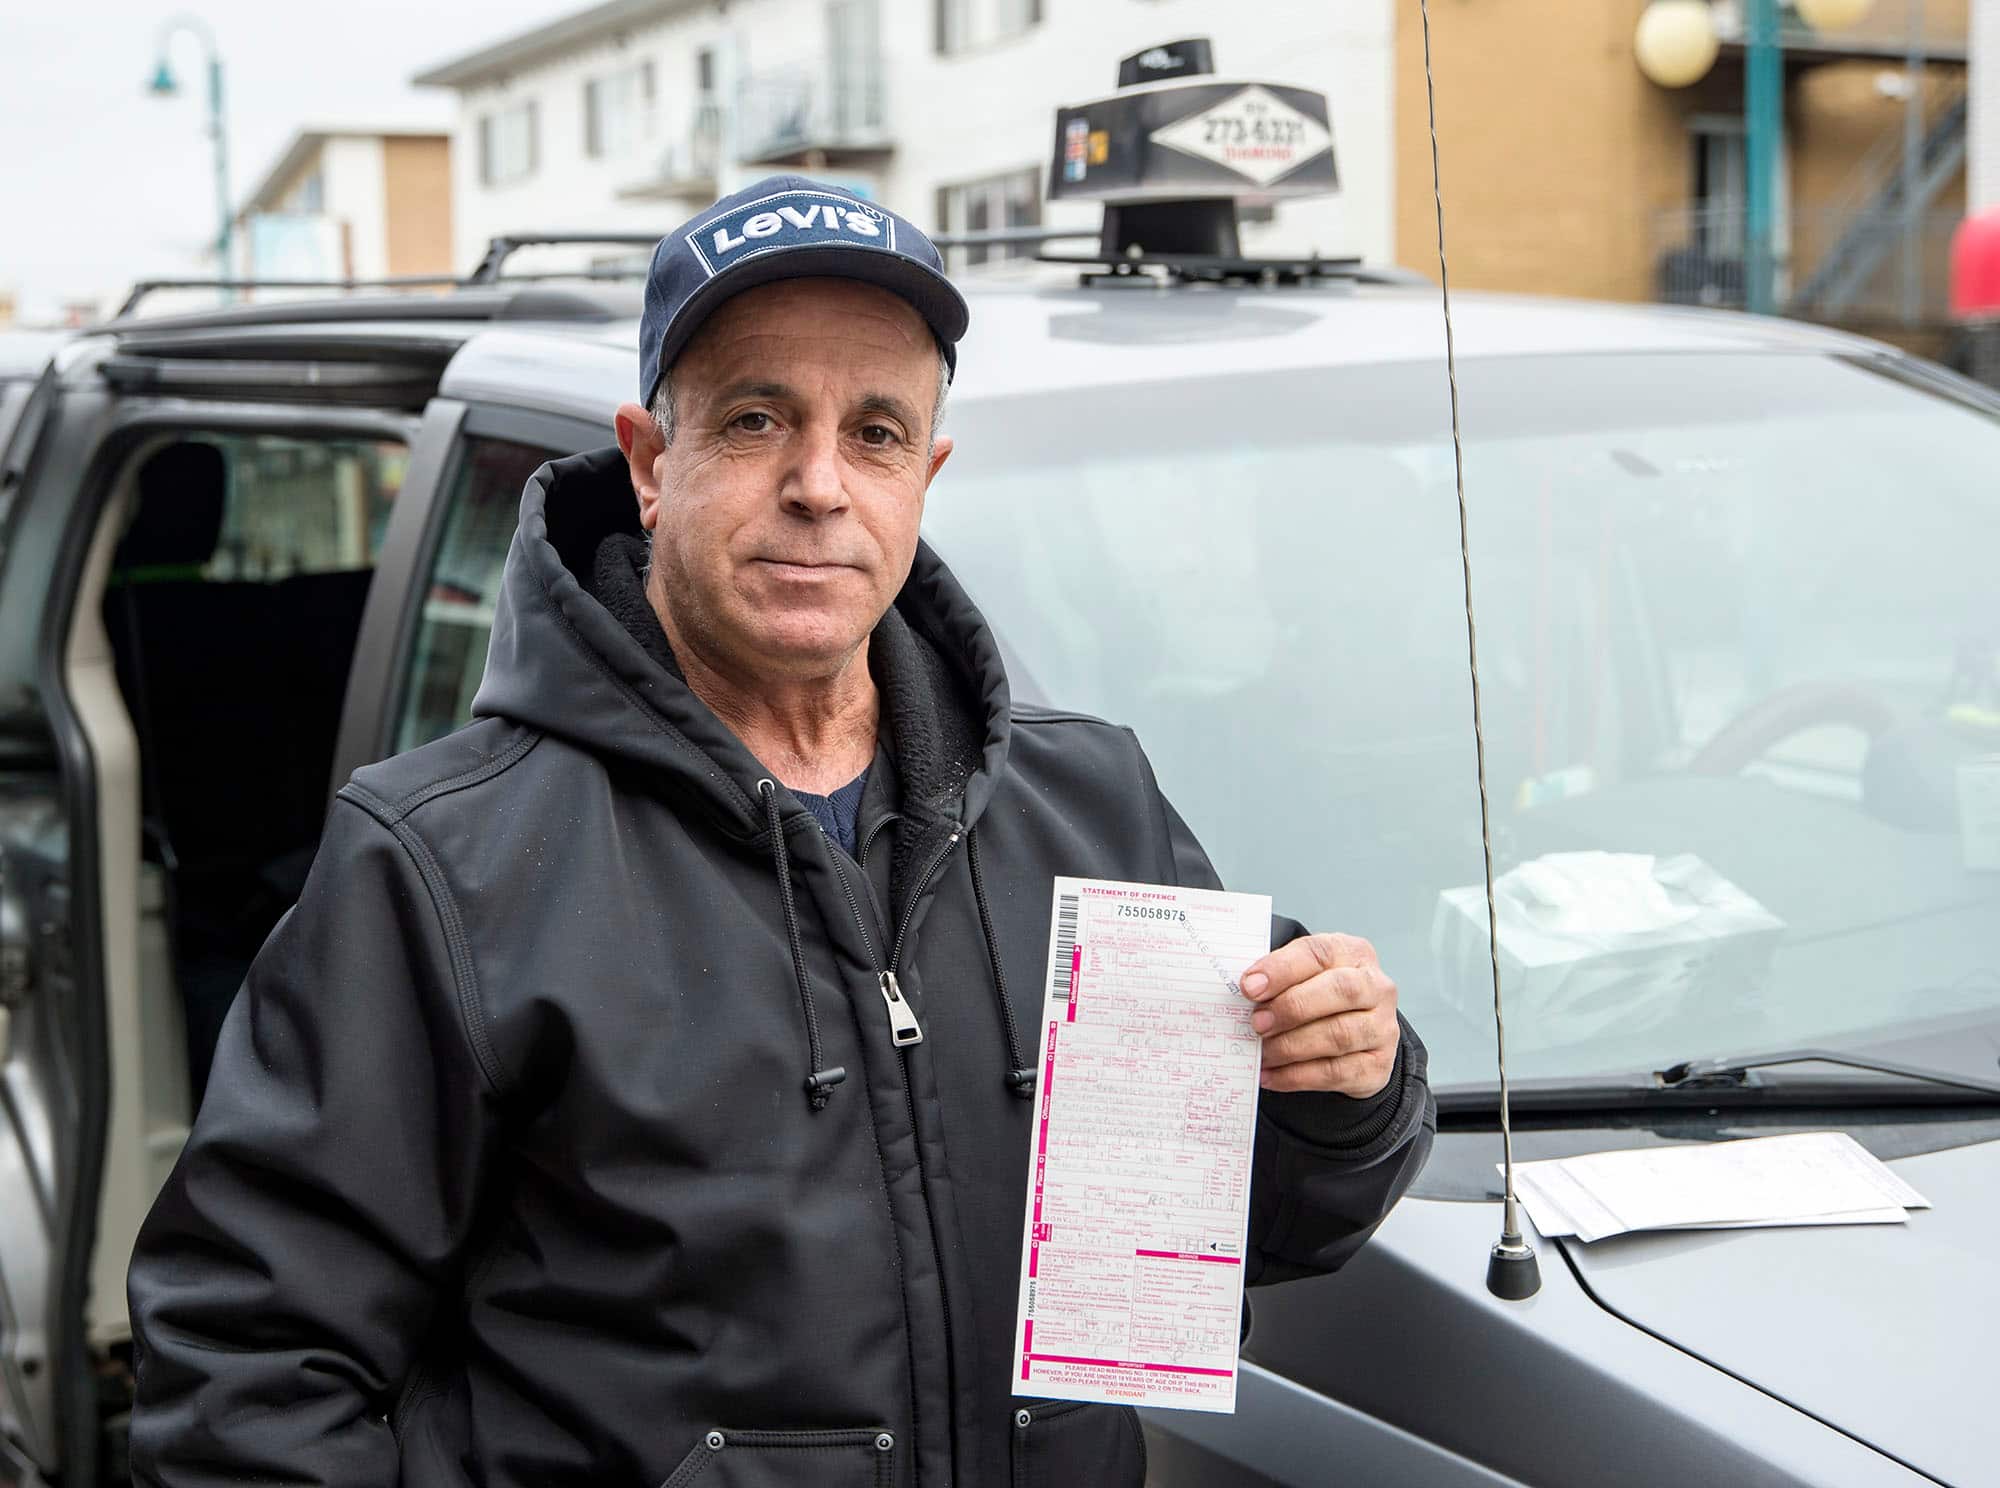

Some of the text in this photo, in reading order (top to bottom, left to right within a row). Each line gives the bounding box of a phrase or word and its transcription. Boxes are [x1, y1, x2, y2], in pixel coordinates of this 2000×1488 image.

[1082, 887, 1128, 897] STATEMENT
[1142, 892, 1177, 902] OFFENCE
[1117, 905, 1186, 922] 755058975
[1041, 1095, 1050, 1120] Offence
[1049, 1376, 1077, 1384] CHECKED
[1105, 1389, 1145, 1398] DEFENDANT
